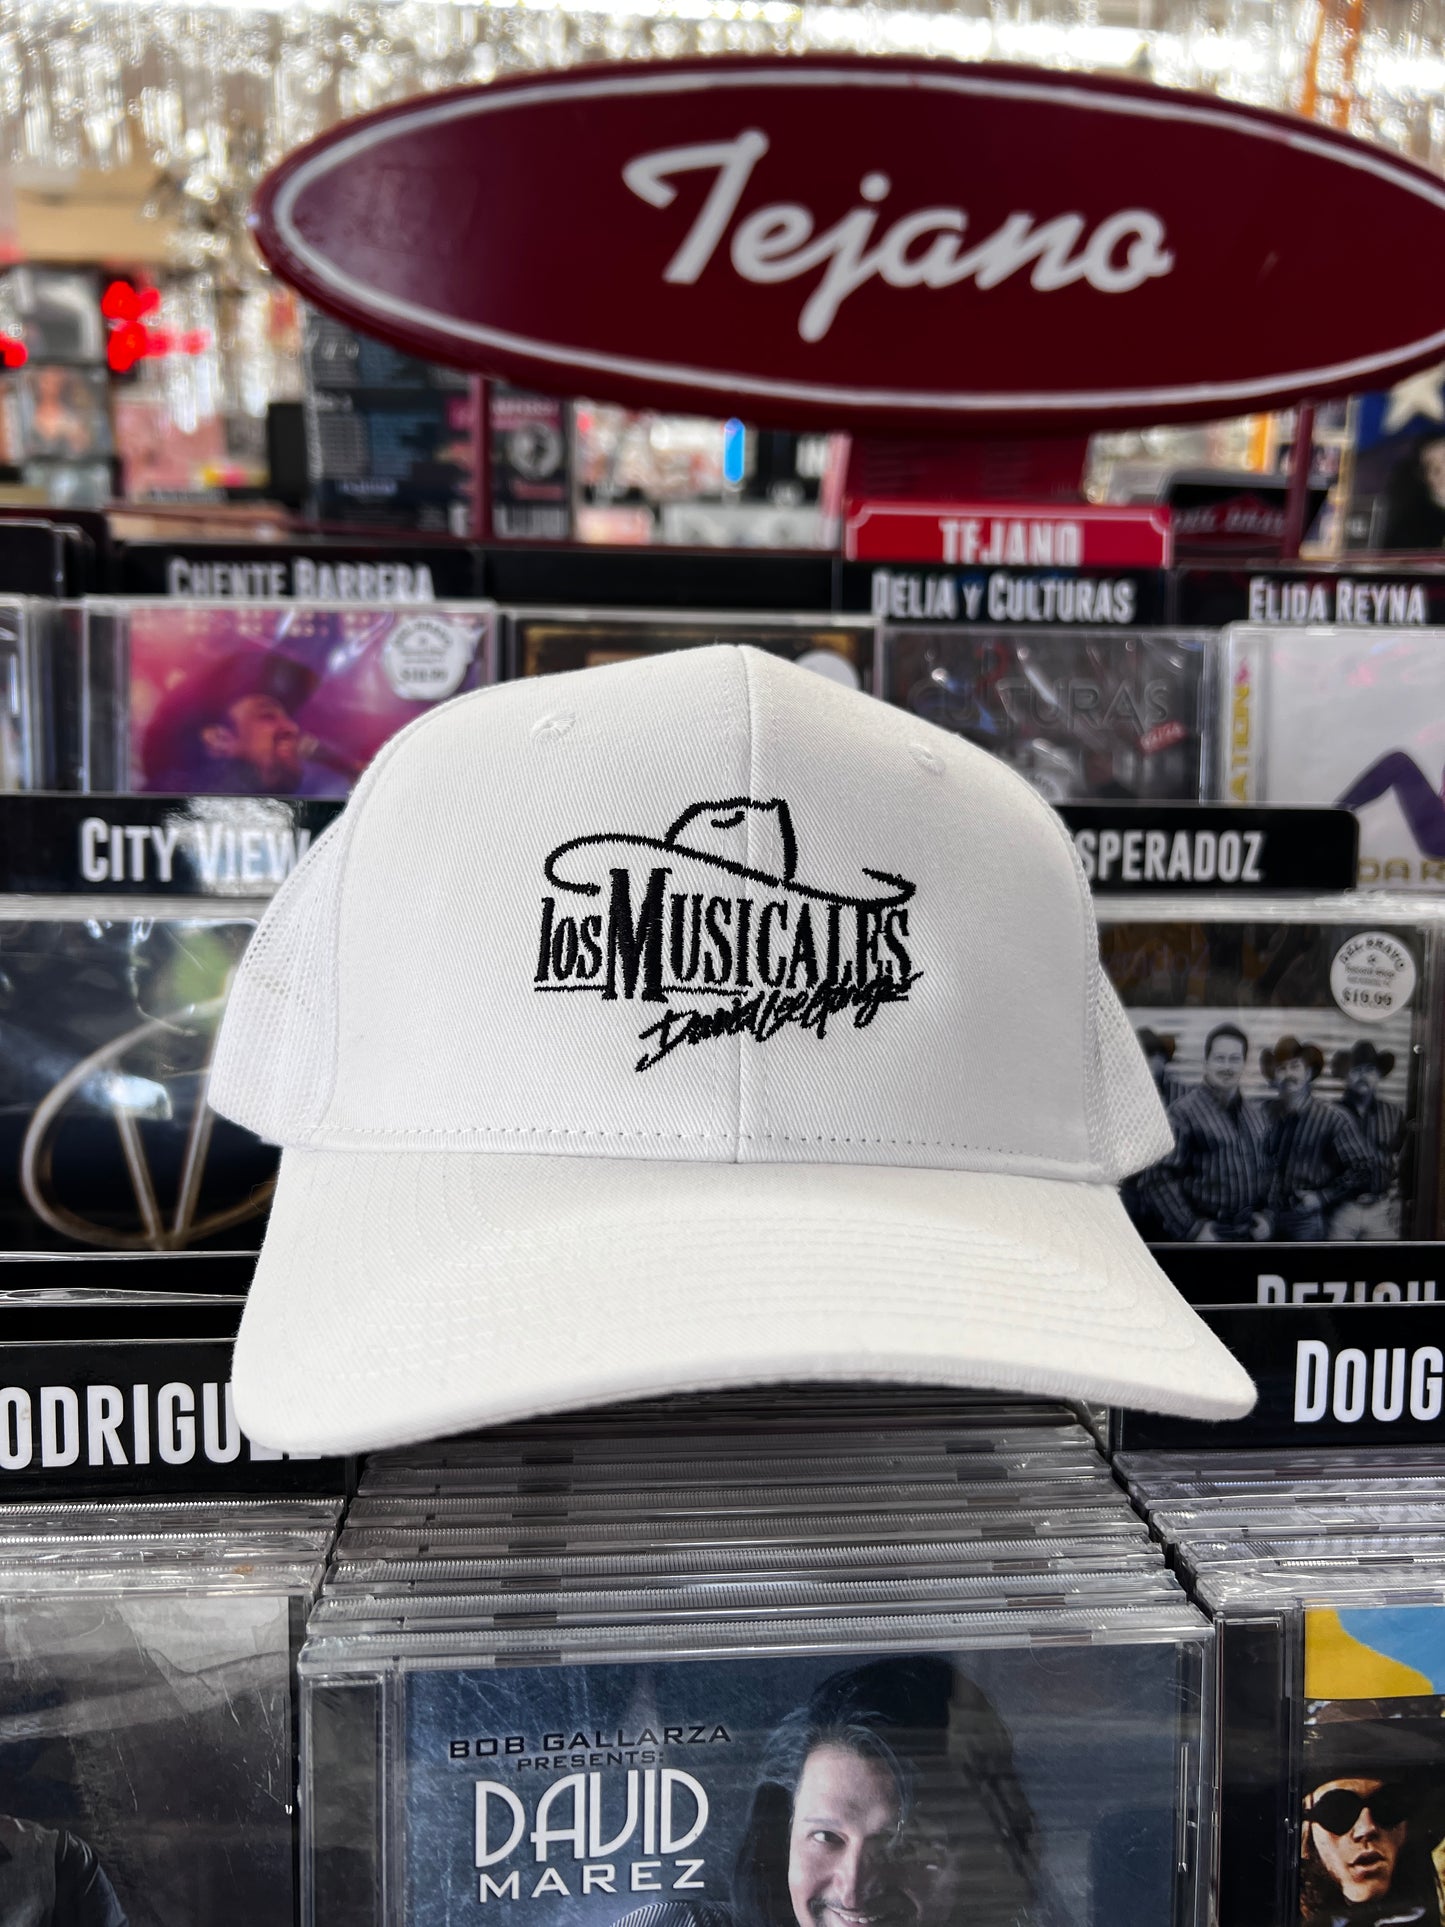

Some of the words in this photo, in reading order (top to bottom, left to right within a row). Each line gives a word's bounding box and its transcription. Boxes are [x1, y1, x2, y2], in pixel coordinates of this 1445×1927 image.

[622, 128, 1175, 343] Tejano
[938, 517, 1083, 566] TEJANO
[165, 558, 288, 600] CHENTE
[292, 558, 437, 602] BARRERA
[871, 570, 958, 619] DELIA
[987, 572, 1136, 624] CULTURAS
[1249, 576, 1330, 623] ELIDA
[1336, 578, 1426, 624] REYNA
[80, 816, 179, 883] CITY
[1073, 829, 1264, 882] SPERADOZ
[534, 898, 602, 982] los
[602, 867, 913, 1003] MUSICALES
[1294, 1340, 1444, 1423] DOUG
[0, 1381, 322, 1470] ODRIGU
[449, 1736, 525, 1758] BOB
[542, 1725, 732, 1752] GALLARZA
[517, 1750, 665, 1772] PRESENTS:
[475, 1768, 709, 1868] DAVID
[479, 1858, 705, 1903] MAREZ
